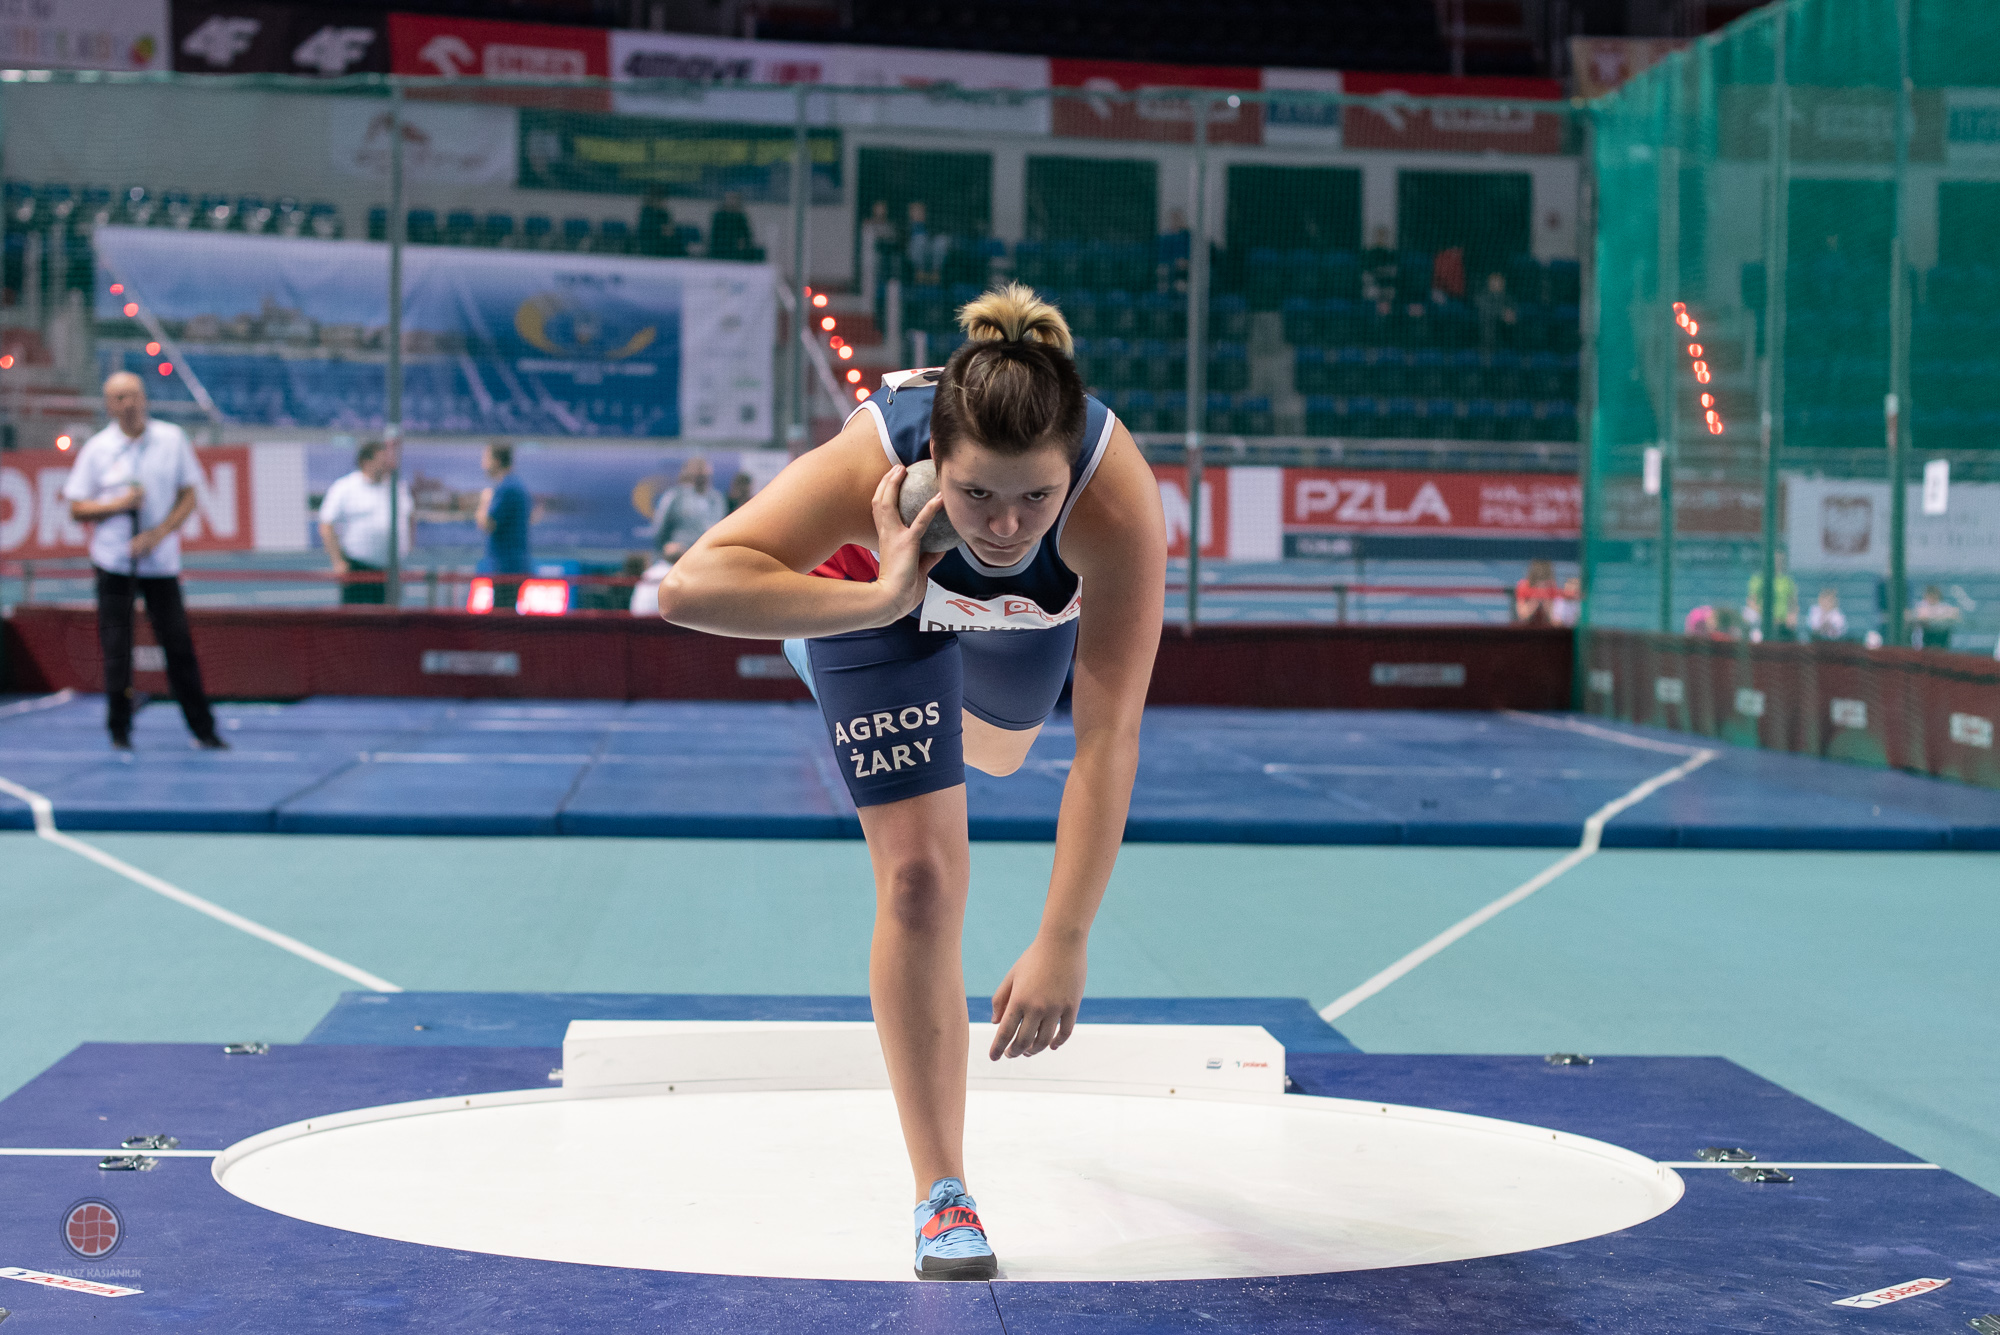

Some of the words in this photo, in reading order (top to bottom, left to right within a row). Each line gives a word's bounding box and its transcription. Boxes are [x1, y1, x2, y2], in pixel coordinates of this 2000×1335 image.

[1295, 479, 1451, 523] PZLA
[836, 702, 940, 746] AGROS
[850, 738, 933, 778] ŻARY
[937, 1209, 982, 1231] NIKE
